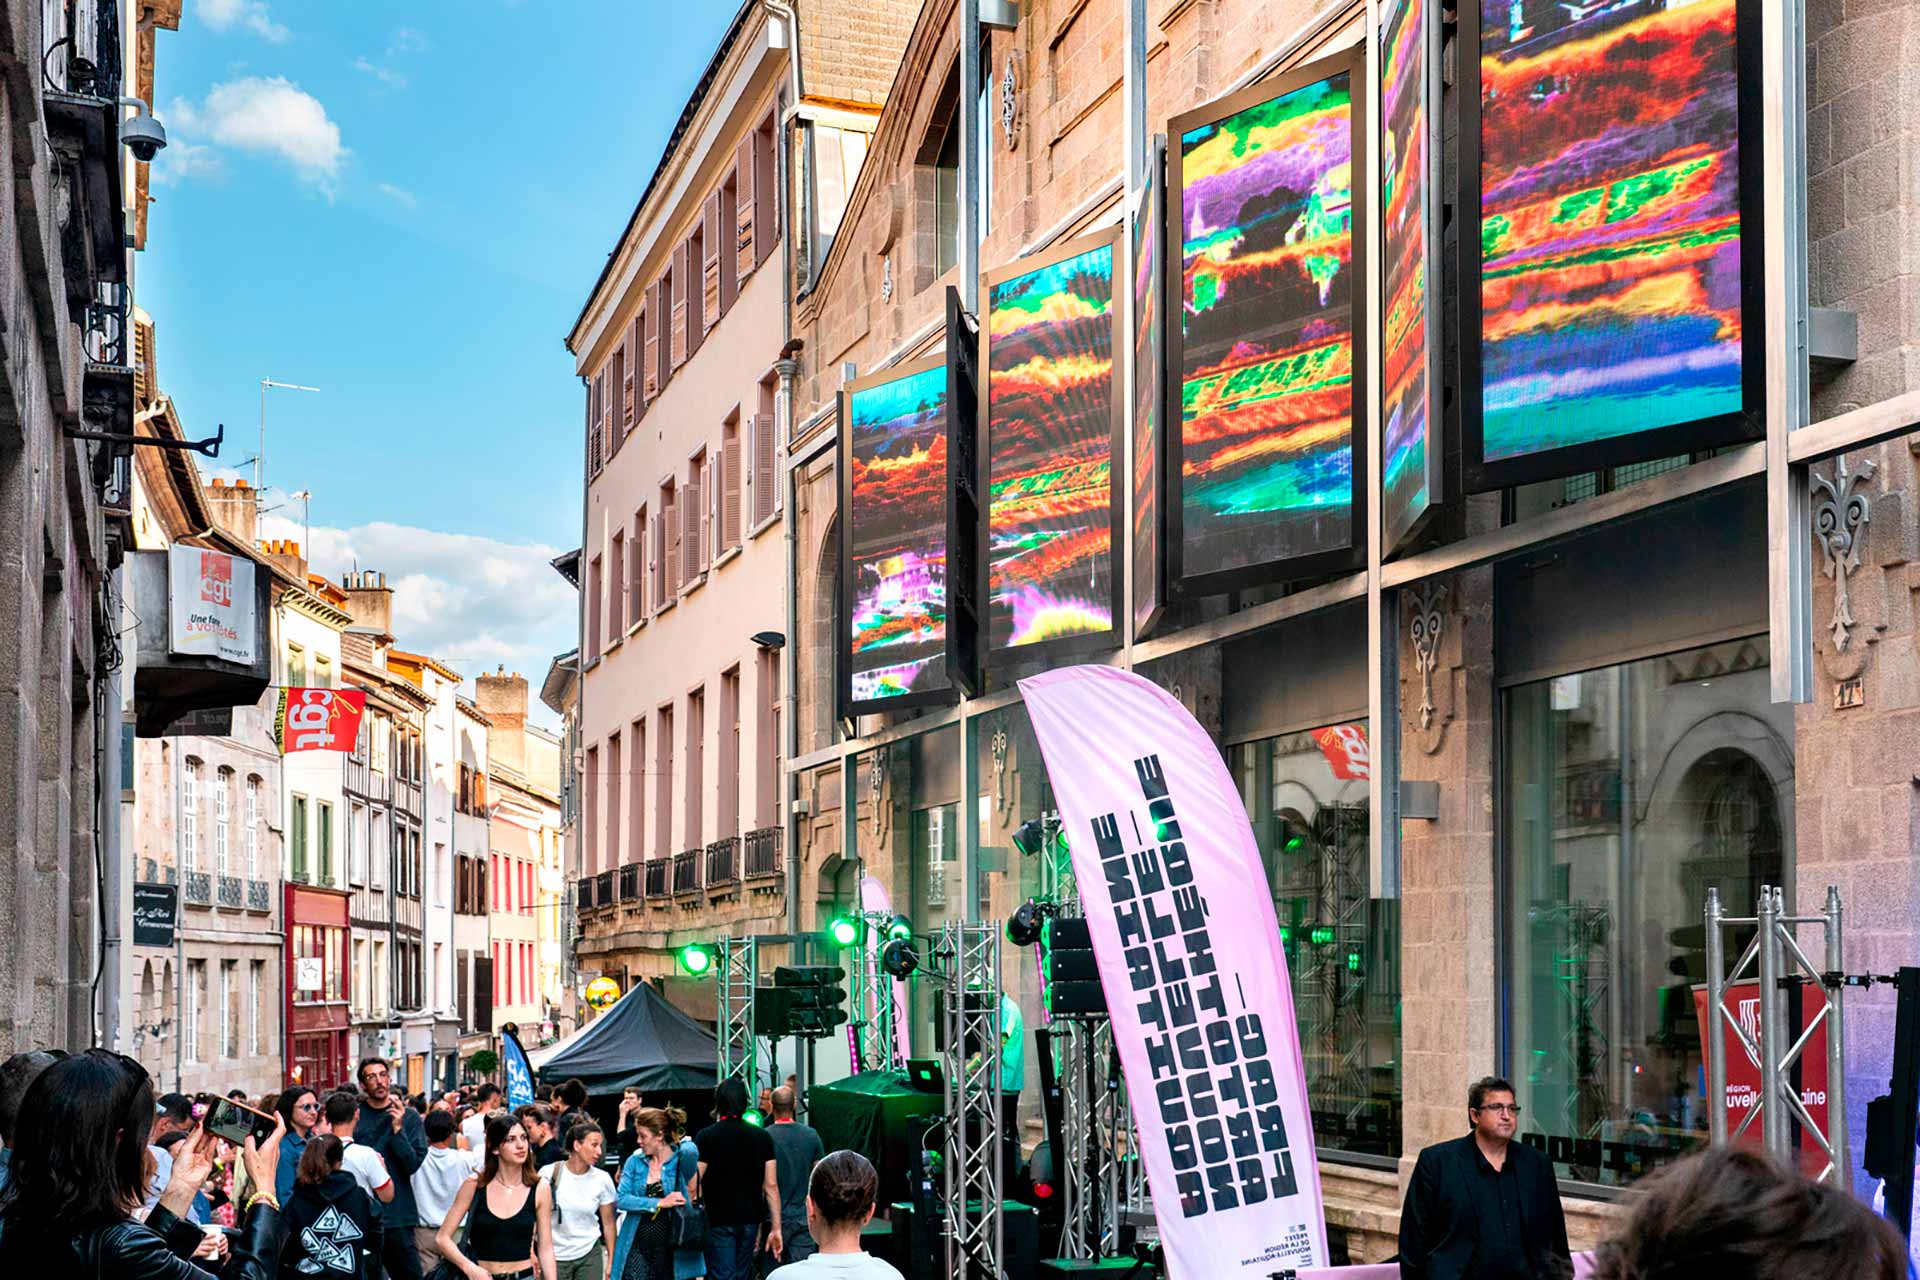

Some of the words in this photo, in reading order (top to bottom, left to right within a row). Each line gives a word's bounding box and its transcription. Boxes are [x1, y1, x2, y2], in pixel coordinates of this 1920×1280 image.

[201, 577, 232, 603] cgt
[191, 614, 207, 623] Une
[288, 689, 336, 749] cgt
[323, 1217, 335, 1227] 23
